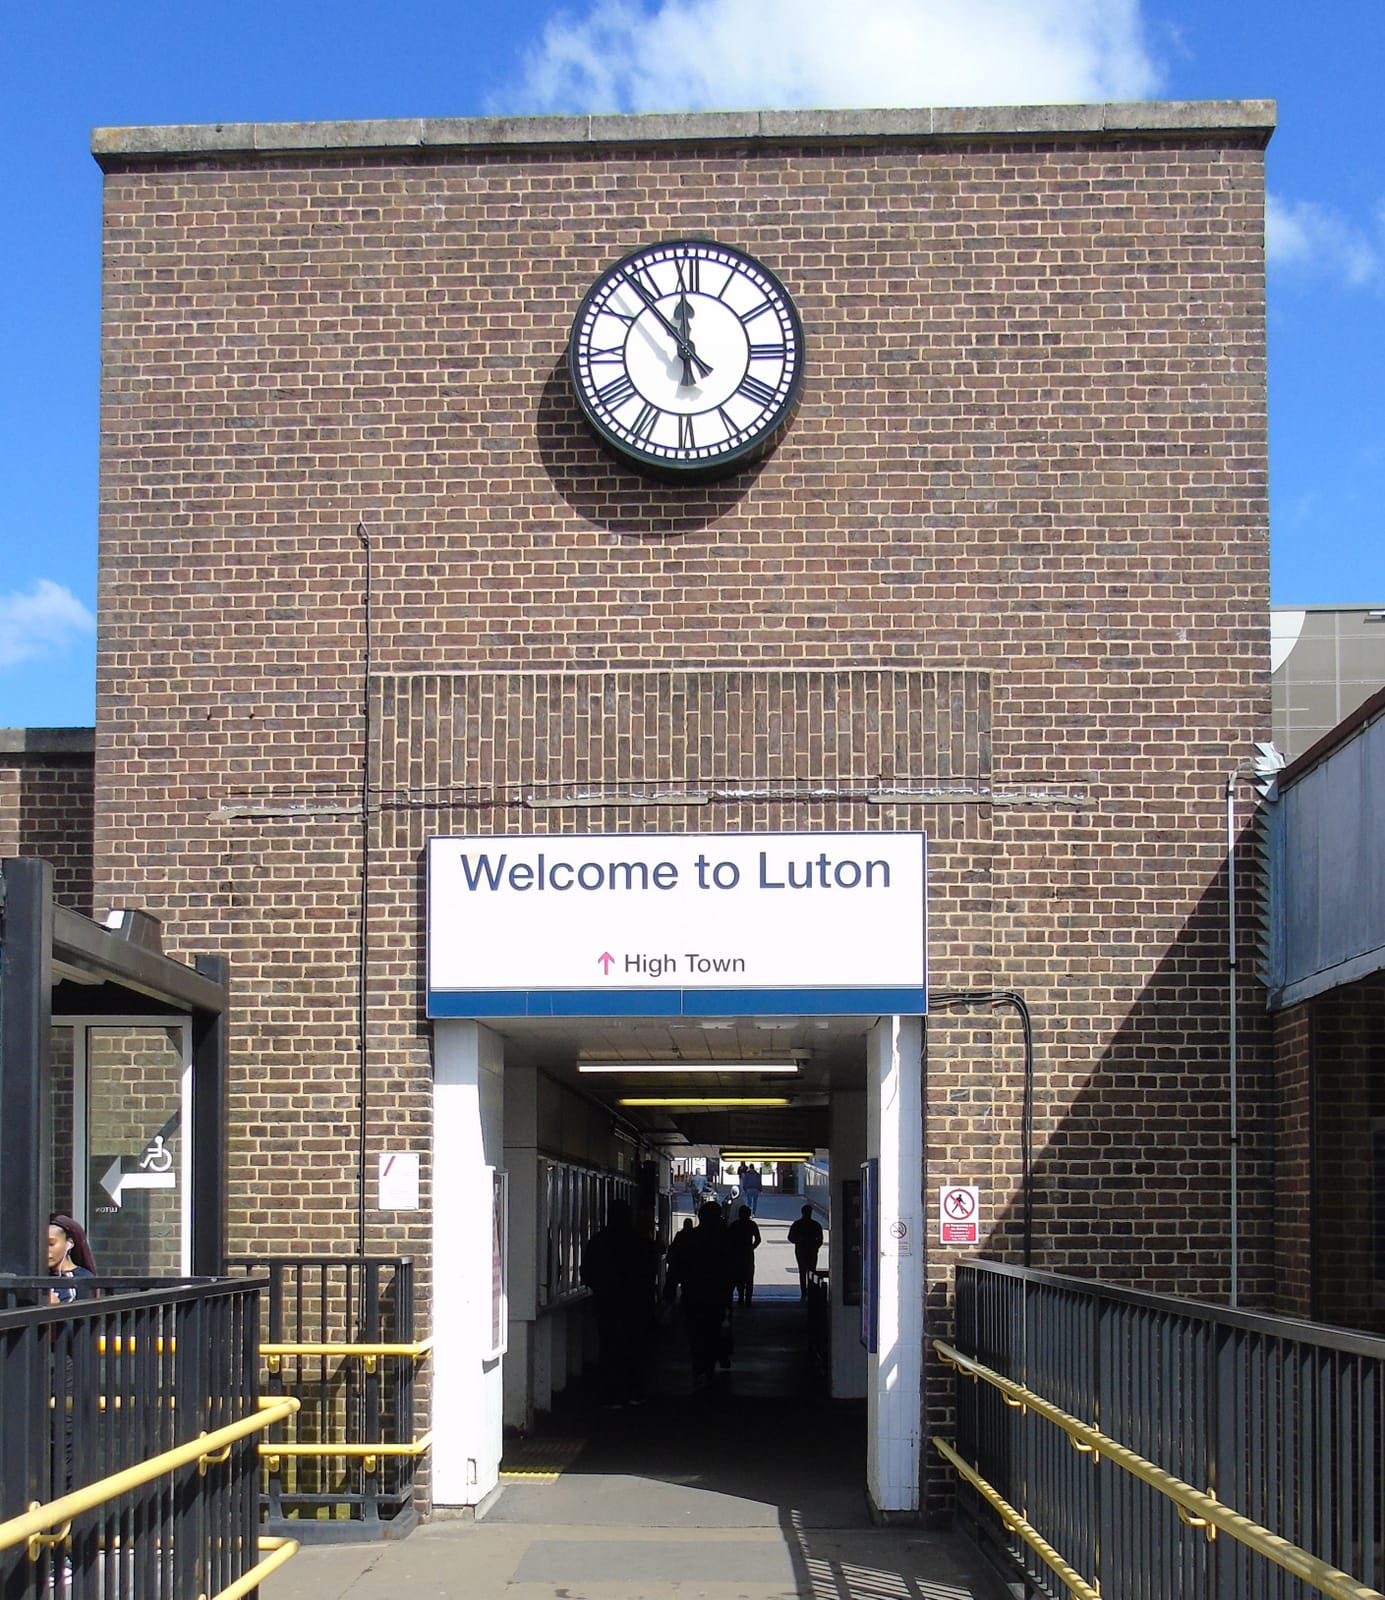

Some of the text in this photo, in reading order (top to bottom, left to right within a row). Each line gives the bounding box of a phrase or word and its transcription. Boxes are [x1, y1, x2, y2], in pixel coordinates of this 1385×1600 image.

[750, 343, 785, 360] III
[461, 852, 891, 892] Welcome to Luton
[624, 953, 746, 977] High Town
